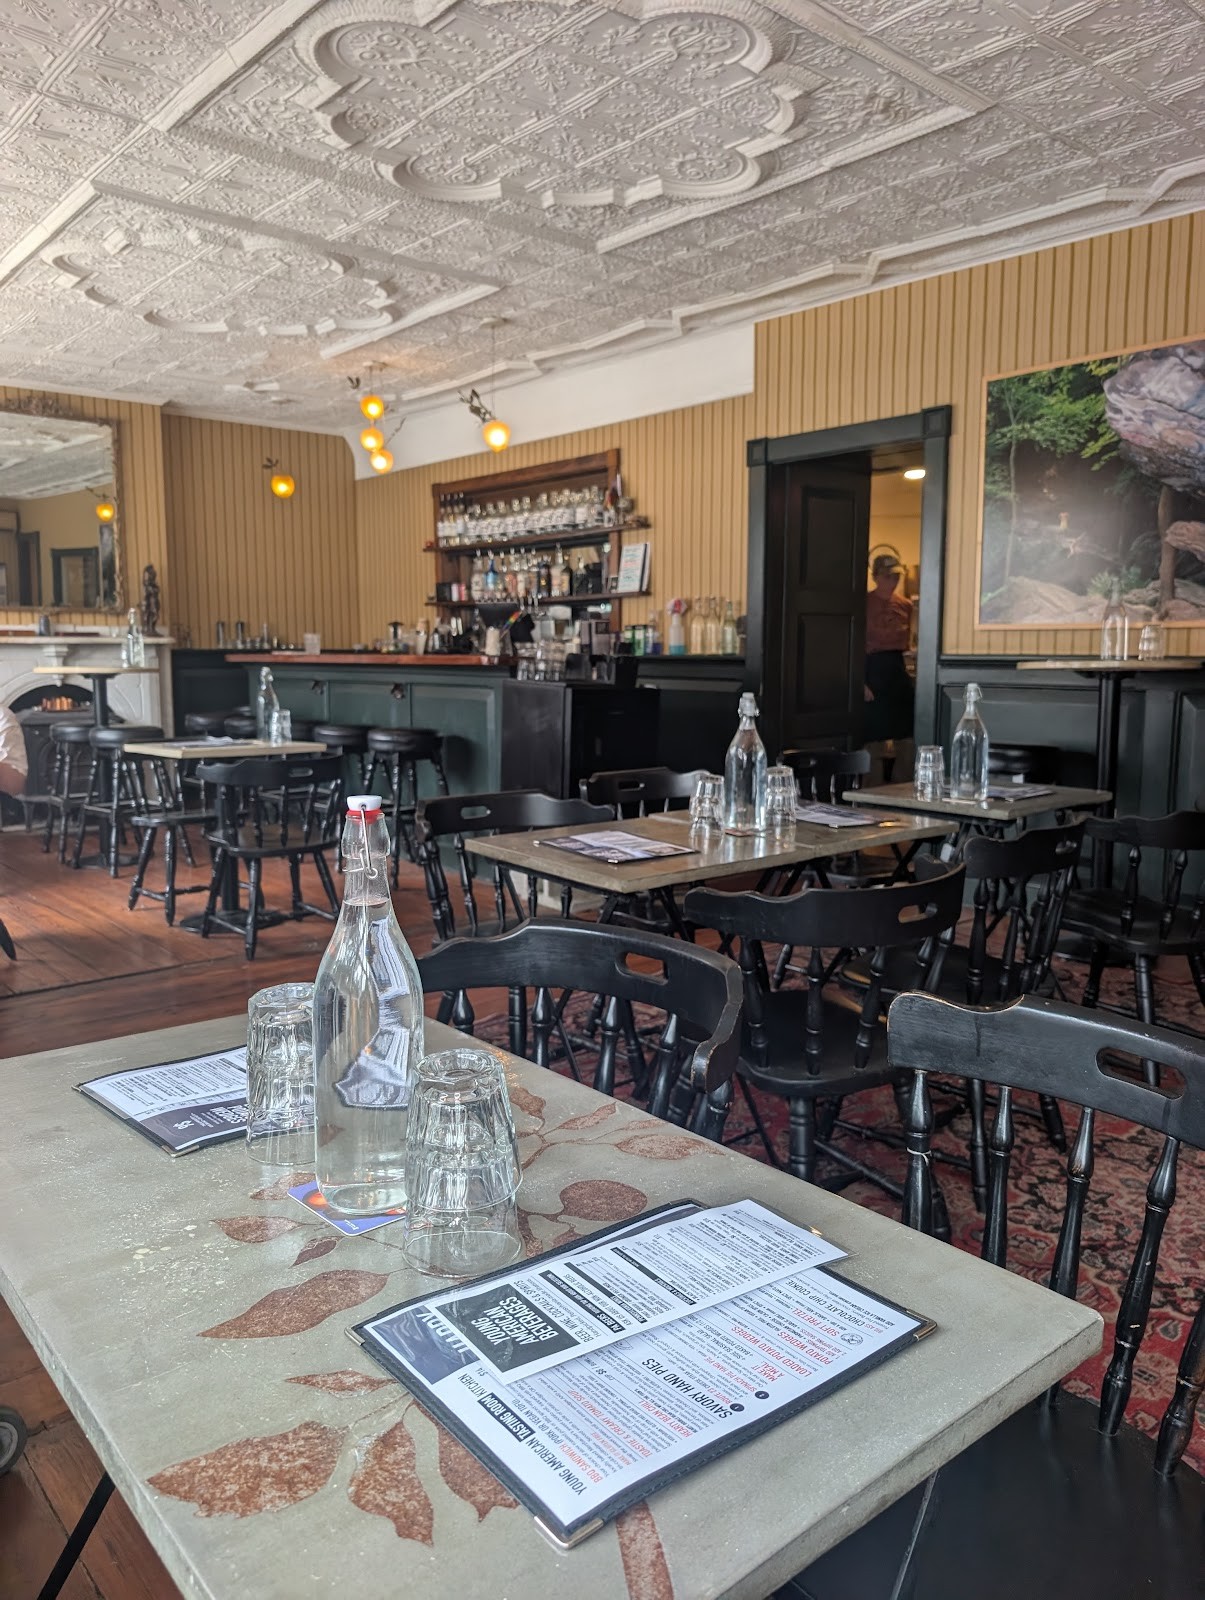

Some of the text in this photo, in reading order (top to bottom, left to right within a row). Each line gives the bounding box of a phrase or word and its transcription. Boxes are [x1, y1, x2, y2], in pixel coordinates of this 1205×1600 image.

[784, 1280, 811, 1295] COOKIE
[807, 1293, 827, 1305] CHIP
[483, 1305, 539, 1346] AMERICAN
[496, 1295, 560, 1340] BEVERAGES
[790, 1307, 840, 1336] SOFT PRETZEL
[823, 1303, 866, 1326] CHOCOLATE
[468, 1315, 511, 1345] YOUNG
[730, 1325, 812, 1376] LOADED POTATO WEDGES
[776, 1330, 833, 1364] POTATO WEDGES
[640, 1357, 669, 1375] PIES
[756, 1368, 778, 1381] MAKE
[662, 1372, 695, 1393] HAND
[580, 1399, 604, 1417] TOMATO
[687, 1389, 733, 1419] SAVORY
[522, 1409, 543, 1425] VEGAN
[600, 1416, 626, 1435] CREAMY
[652, 1409, 671, 1422] BEAN
[456, 1372, 589, 1495] YOUNG AMERICAN TASTING ROOM KITCHEN
[666, 1419, 693, 1437] HEARTY
[557, 1443, 591, 1471] SANDWICH
